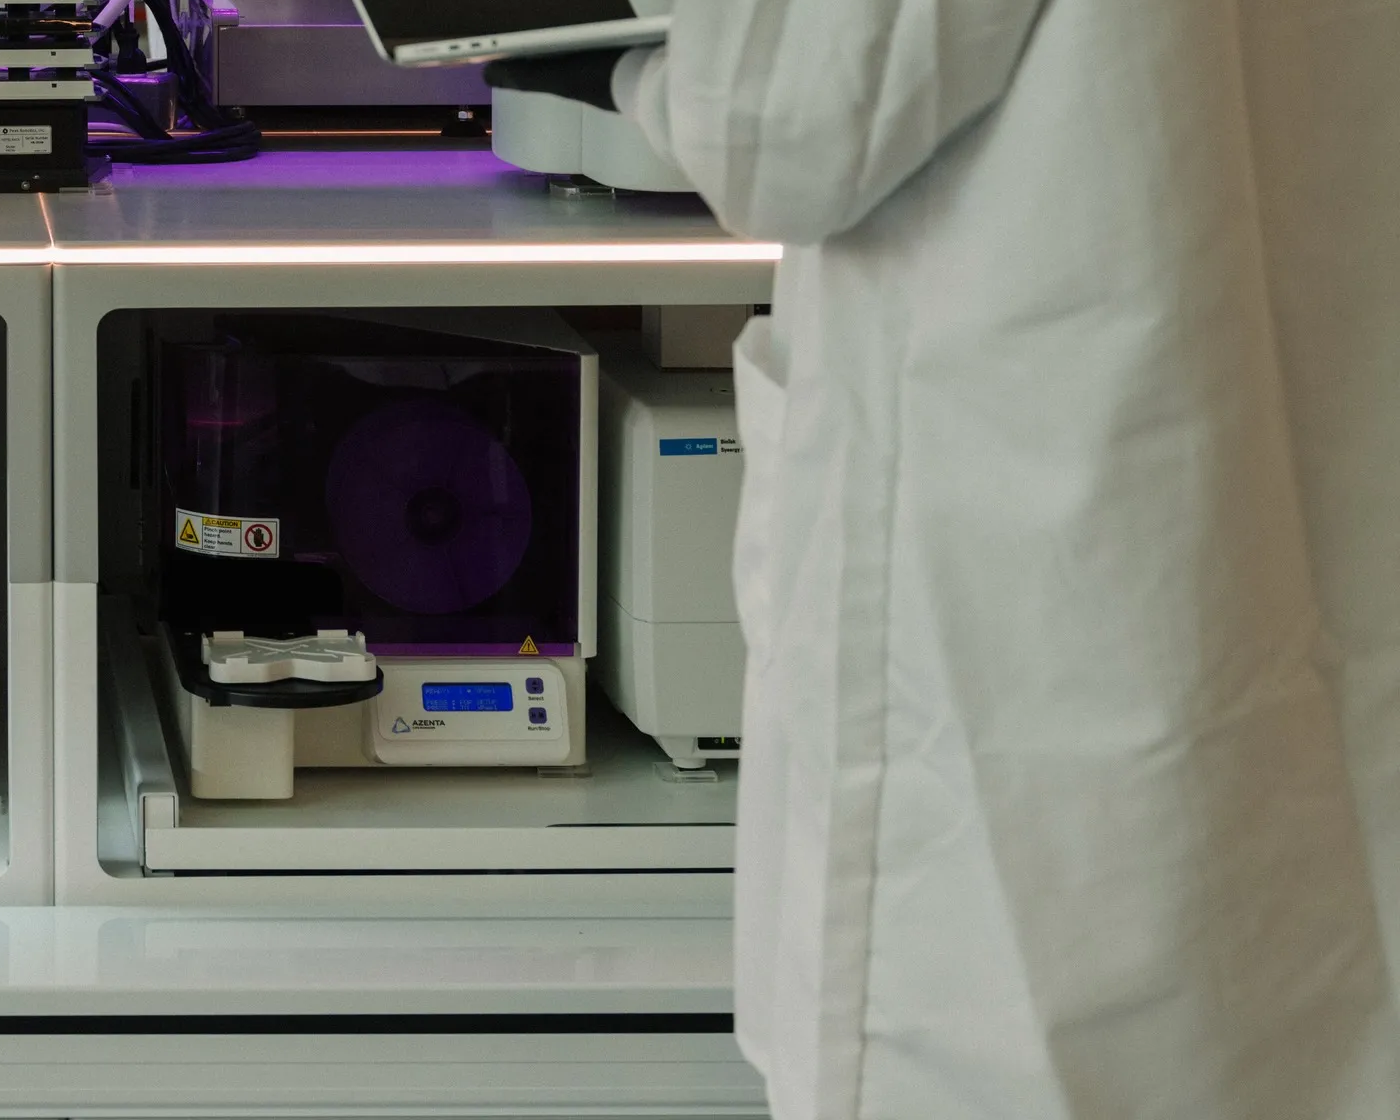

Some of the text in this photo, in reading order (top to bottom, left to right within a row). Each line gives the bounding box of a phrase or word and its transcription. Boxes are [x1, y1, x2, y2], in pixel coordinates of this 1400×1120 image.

[211, 519, 239, 528] CAUTION
[204, 538, 217, 546] Keep
[412, 719, 446, 727] AZENTA
